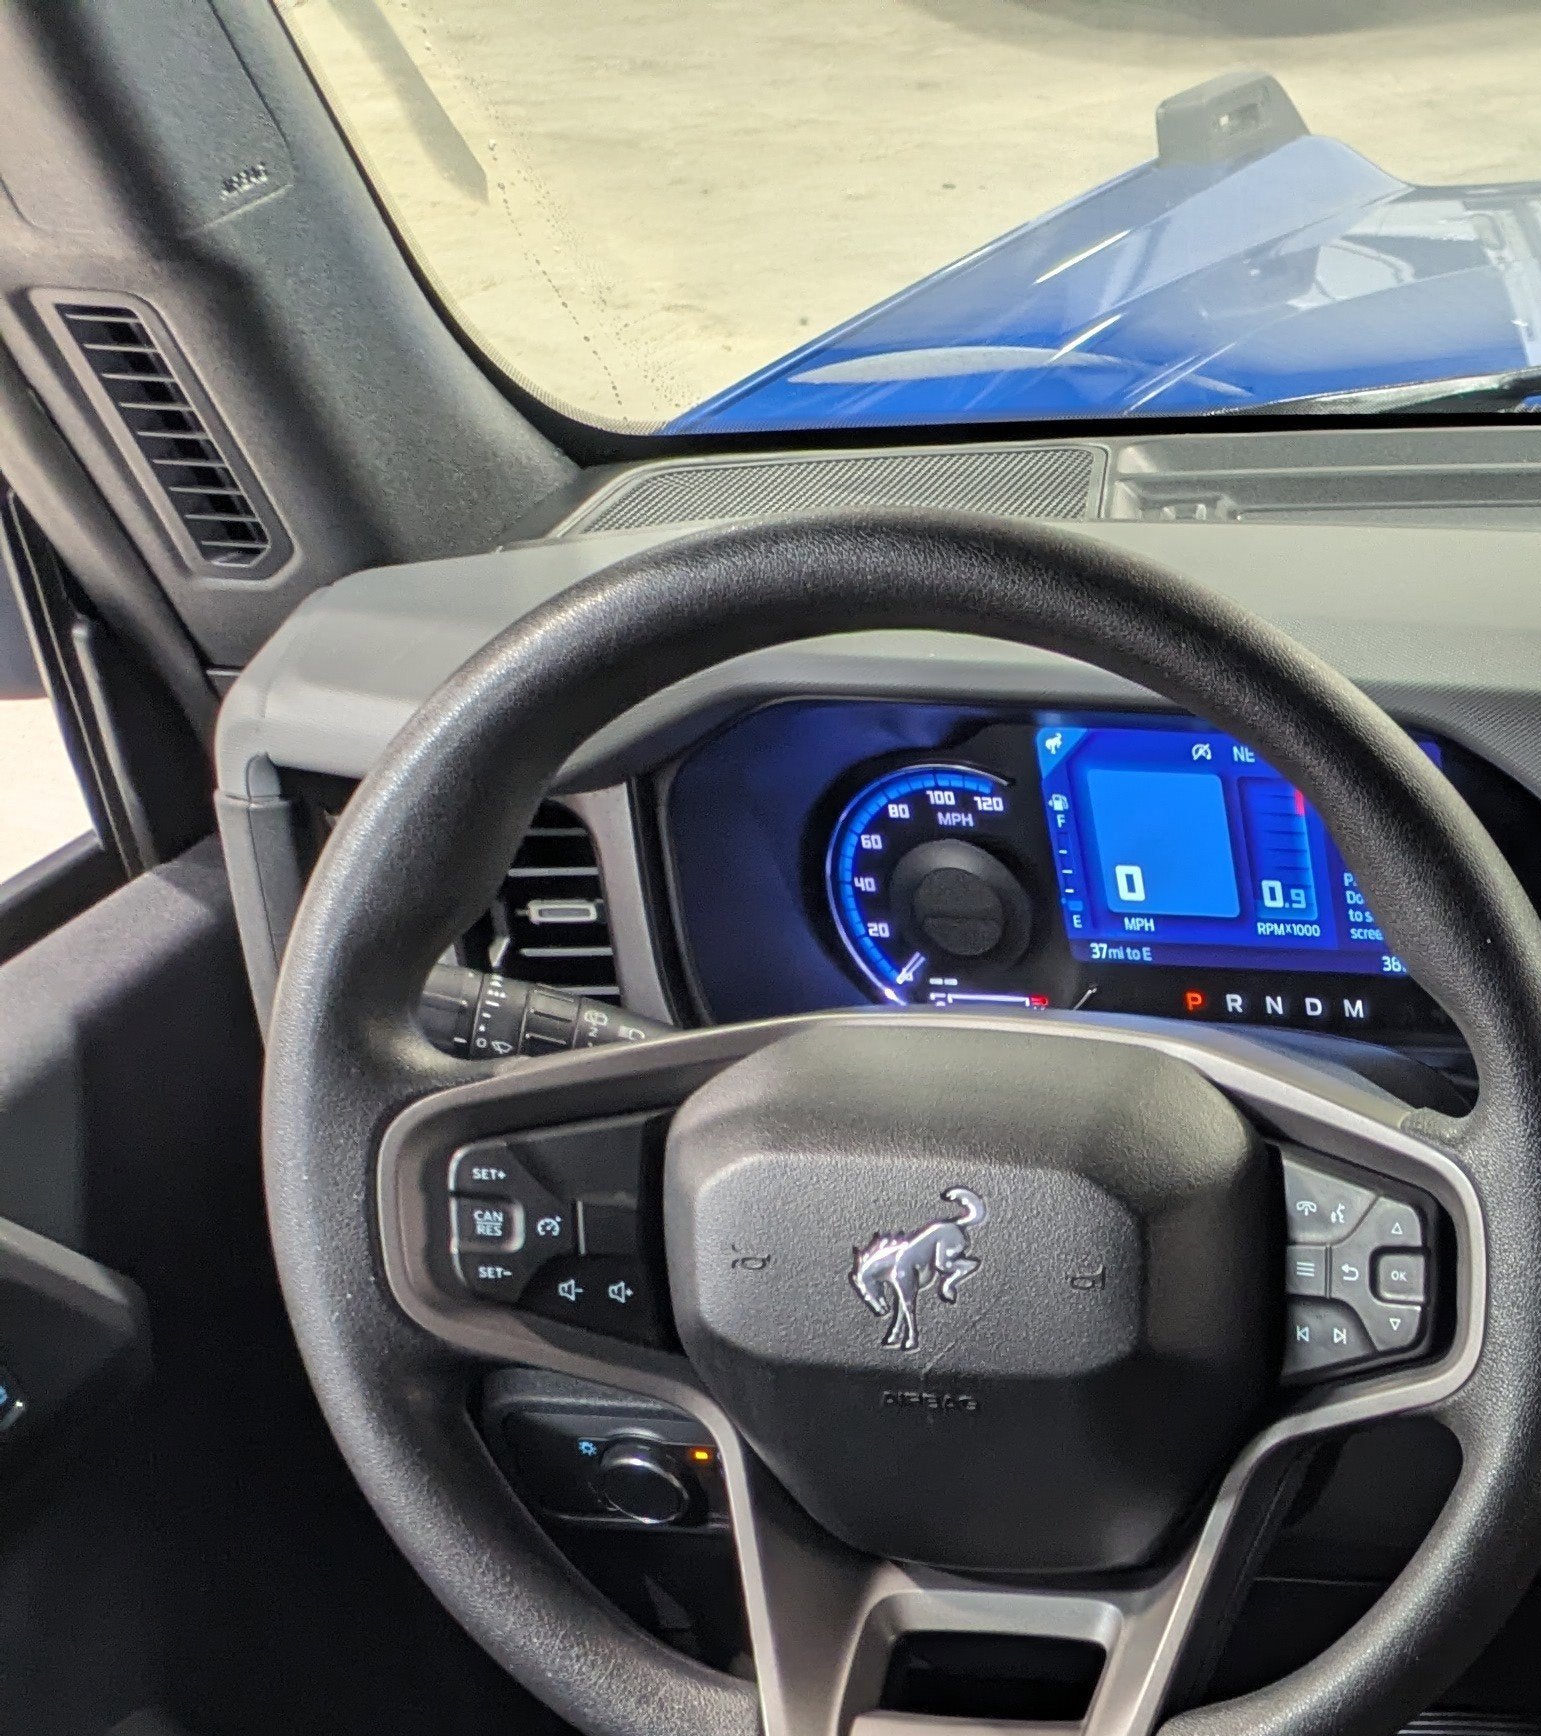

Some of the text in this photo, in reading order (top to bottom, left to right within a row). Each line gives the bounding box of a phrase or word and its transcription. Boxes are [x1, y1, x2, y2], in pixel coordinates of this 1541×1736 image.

[926, 790, 956, 806] 100
[973, 796, 1004, 811] 120
[887, 804, 911, 820] 80
[936, 811, 974, 828] MPH
[860, 833, 883, 850] 60
[853, 876, 876, 893] 40
[1114, 864, 1147, 902] 0
[1072, 914, 1083, 929] E
[1124, 916, 1156, 933] MPH
[867, 922, 891, 938] 20
[1185, 991, 1365, 1019] P R N D M
[473, 1210, 504, 1223] CAN
[475, 1223, 503, 1237] RES
[1390, 1270, 1408, 1282] OK
